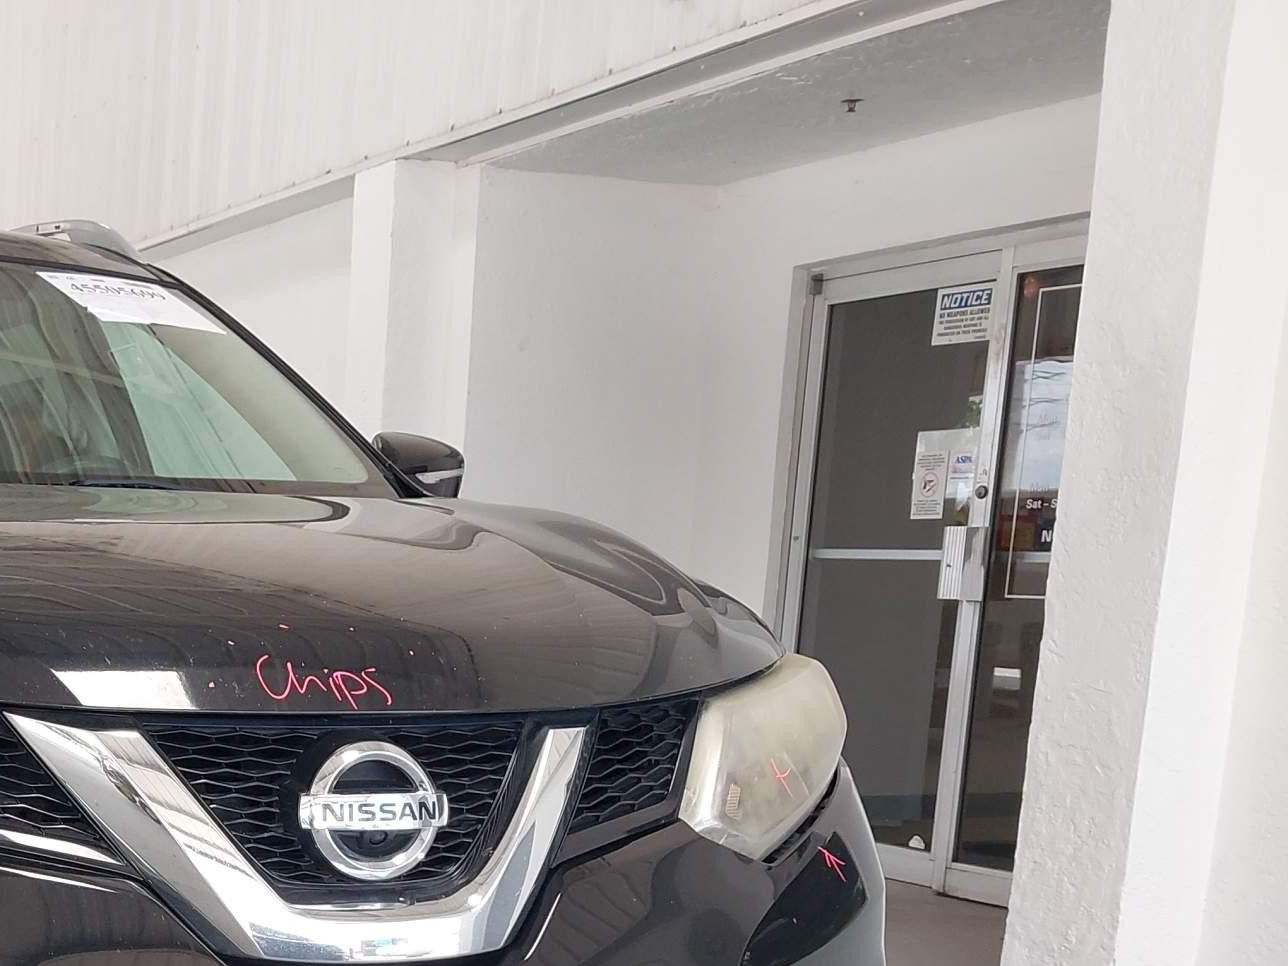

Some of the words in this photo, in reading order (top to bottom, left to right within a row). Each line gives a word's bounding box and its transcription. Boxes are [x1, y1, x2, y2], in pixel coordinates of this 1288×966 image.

[942, 290, 991, 308] NOTICE
[1025, 499, 1042, 509] Sat
[321, 801, 437, 822] NISSAN
